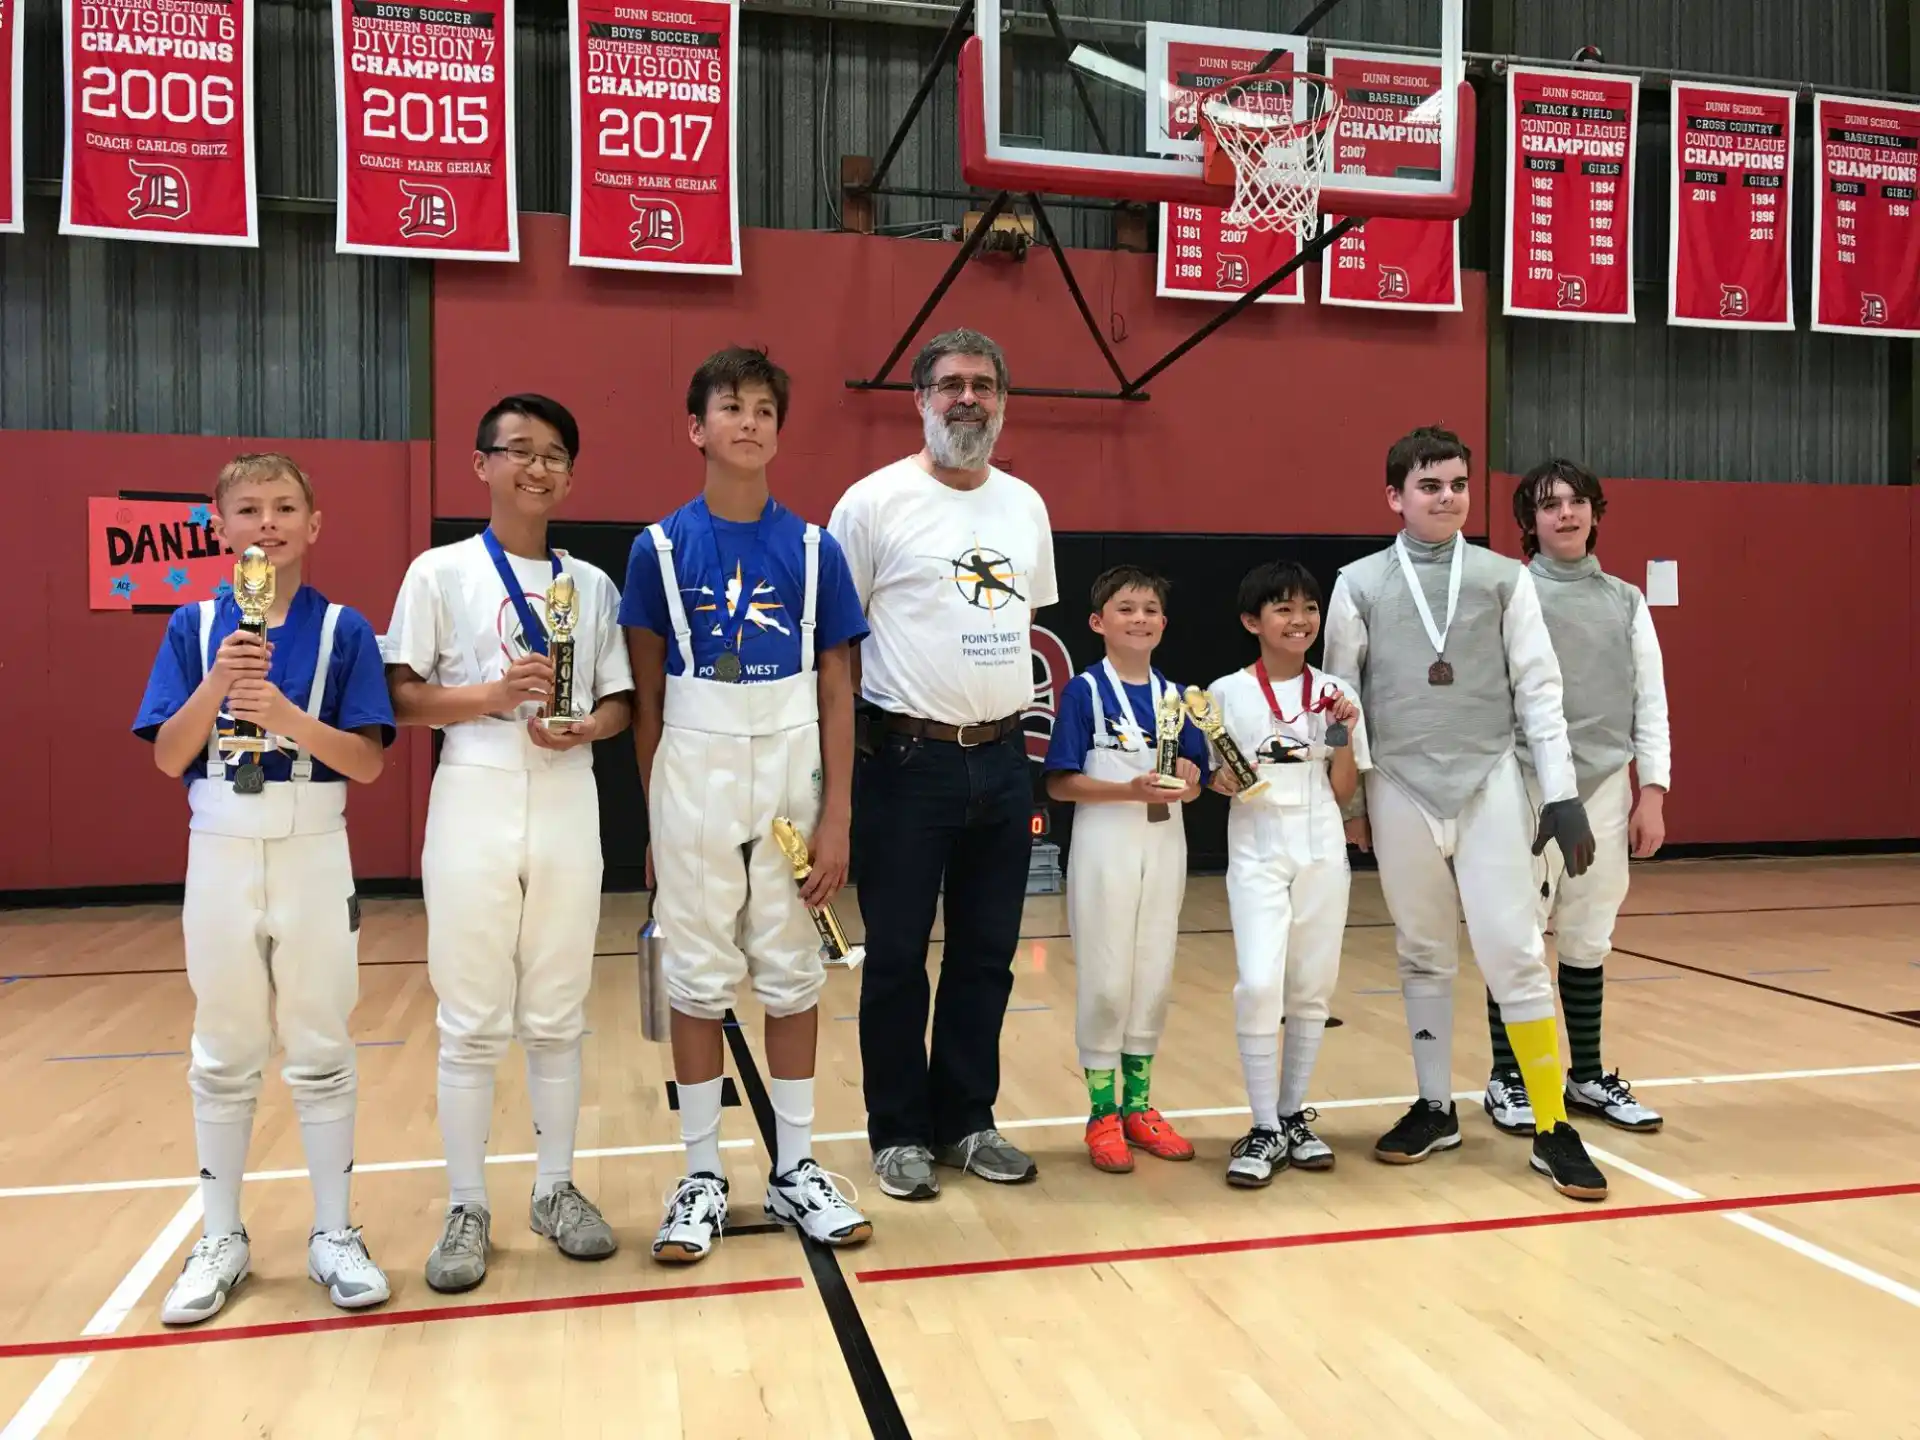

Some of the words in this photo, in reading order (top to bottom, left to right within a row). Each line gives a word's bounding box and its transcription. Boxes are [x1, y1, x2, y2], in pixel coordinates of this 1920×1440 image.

[157, 0, 231, 16] SECTIONAL
[376, 5, 413, 19] BOYS'
[419, 9, 472, 24] SOCCER
[614, 7, 648, 20] DUNN
[651, 11, 696, 25] SCHOOL
[81, 6, 208, 38] DIVISION
[219, 17, 235, 40] 6
[352, 16, 421, 34] SOUTHERN
[425, 24, 495, 41] SECTIONAL
[611, 26, 646, 40] BOYS'
[650, 31, 699, 45] SOCCER
[81, 32, 234, 63] CHAMPIONS
[353, 28, 474, 61] DIVISION
[482, 40, 495, 62] 7
[587, 38, 652, 56] SOUTHERN
[656, 45, 721, 62] SECTIONAL
[351, 53, 495, 83] CHAMPIONS
[588, 51, 701, 81] DIVISION
[708, 60, 721, 83] 6
[1199, 57, 1228, 69] DUNN
[1362, 73, 1390, 85] DUNN
[1393, 76, 1430, 88] SCHOOL
[82, 66, 234, 125] 2006
[587, 75, 721, 104] CHAMPIONS
[1542, 87, 1569, 99] DUNN
[1571, 90, 1606, 102] SCHOOL
[363, 87, 489, 144] 2015
[1340, 105, 1394, 122] CONDOR
[1535, 104, 1568, 116] TRACK
[1571, 108, 1578, 117] &
[1583, 108, 1612, 120] FIELD
[1705, 101, 1730, 113] DUNN
[1733, 104, 1765, 116] SCHOOL
[1520, 119, 1571, 136] CONDOR
[1576, 123, 1627, 139] LEAGUE
[1695, 119, 1726, 131] CROSS
[1730, 122, 1774, 135] COUNTRY
[1845, 114, 1868, 126] DUNN
[1870, 117, 1901, 130] SCHOOL
[599, 108, 713, 162] 2017
[1340, 121, 1442, 145] CHAMPION
[1844, 131, 1902, 147] BASKETBALL
[86, 133, 133, 151] COACH:
[137, 139, 187, 154] CARLOS
[192, 143, 228, 156] ORITZ
[1521, 135, 1625, 158] CHAMPIONS
[1685, 132, 1733, 149] CONDOR
[1737, 136, 1786, 152] LEAGUE
[1340, 145, 1366, 159] 2007
[1684, 147, 1785, 170] CHAMPIONS
[1826, 144, 1871, 161] CONDOR
[1875, 149, 1919, 166] LEAGUE
[360, 154, 404, 169] COACH:
[407, 160, 443, 173] MARK
[447, 162, 492, 175] GERIAK
[1531, 159, 1556, 171] BOYS
[1588, 163, 1620, 175] GIRLS
[1828, 160, 1917, 183] CHAMPIONS
[595, 171, 635, 187] COACH:
[638, 176, 671, 189] MARK
[675, 178, 717, 190] GERIAK
[1695, 171, 1718, 183] BOYS
[1749, 175, 1780, 187] GIRLS
[1590, 181, 1615, 194] 1994
[1692, 188, 1716, 202] 2016
[1836, 182, 1859, 194] BOYS
[1177, 206, 1202, 221] 1975
[1589, 217, 1612, 230] 1997
[1176, 225, 1201, 240] 1981
[1220, 230, 1248, 243] 2007
[1750, 228, 1774, 240] 2015
[1176, 245, 1202, 259] 1985
[1339, 237, 1365, 252] 2014
[1338, 255, 1366, 270] 2015
[1175, 264, 1202, 278] 1986
[1528, 267, 1553, 280] 1970
[106, 519, 234, 567] DANIE
[116, 581, 131, 592] ACE
[961, 634, 999, 644] POINTS
[1000, 631, 1021, 642] WEST
[745, 664, 779, 675] WEST
[559, 645, 572, 716] 2019
[811, 905, 834, 947] 019
